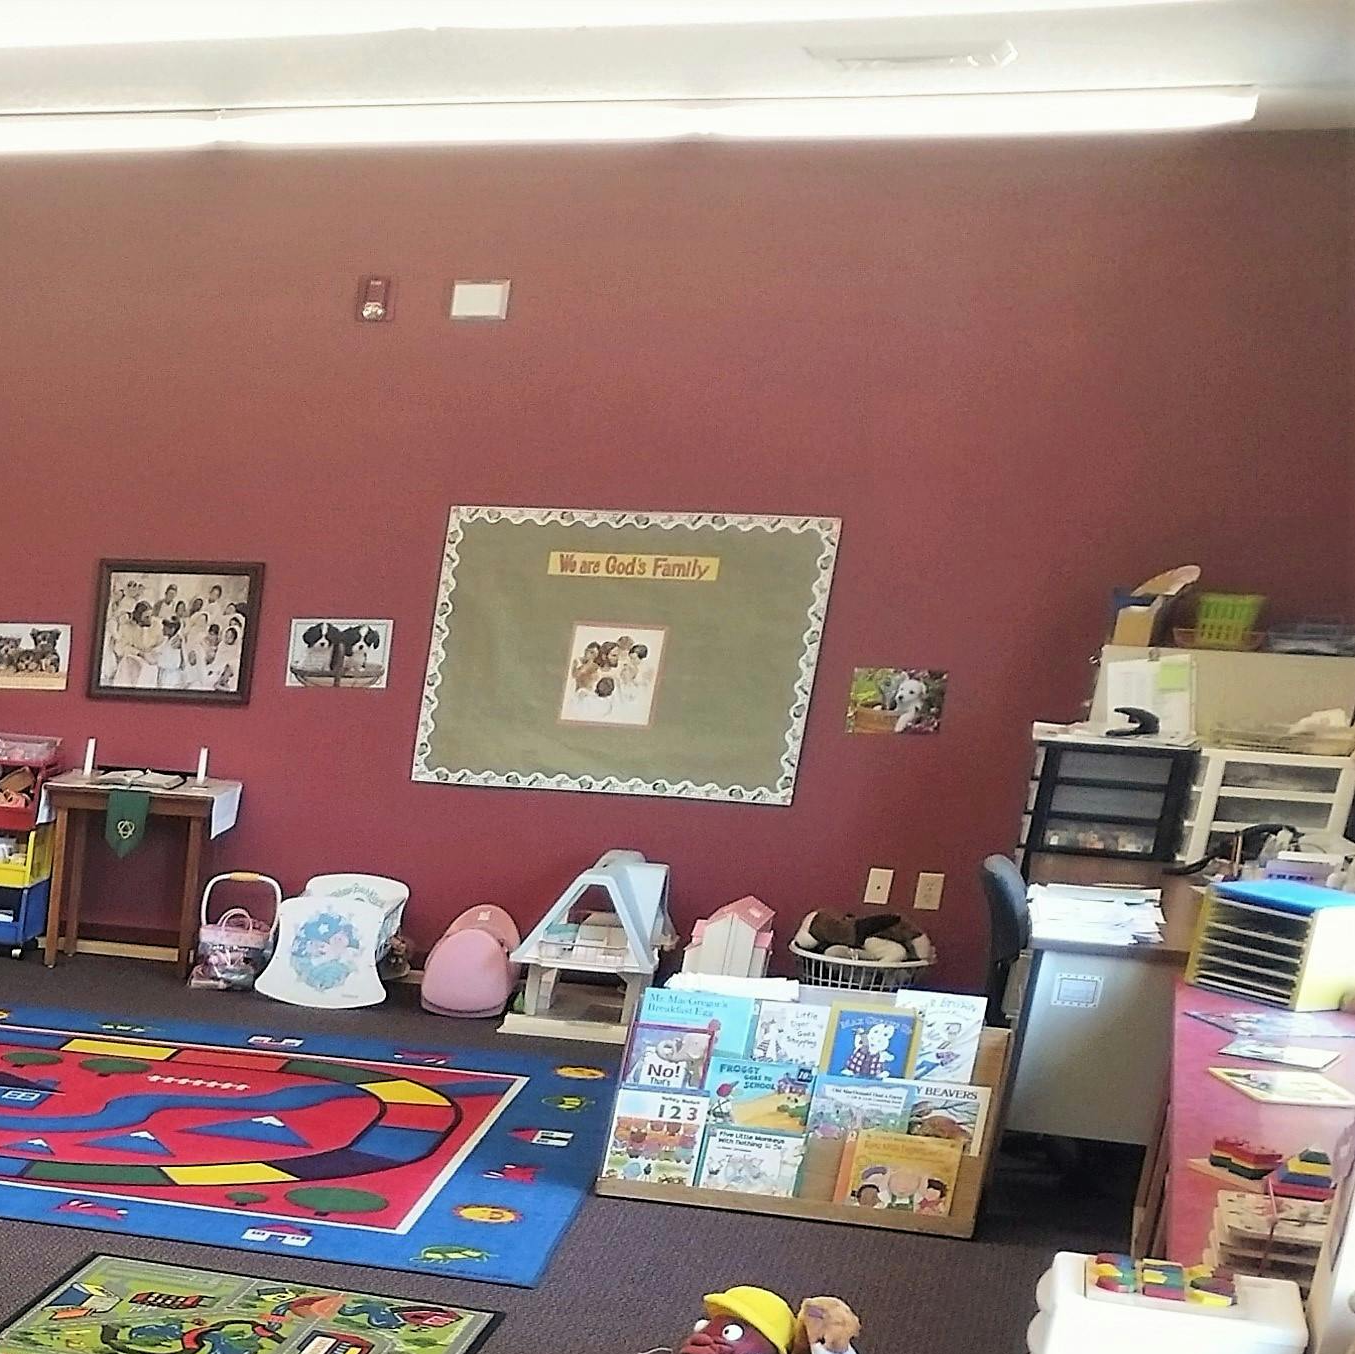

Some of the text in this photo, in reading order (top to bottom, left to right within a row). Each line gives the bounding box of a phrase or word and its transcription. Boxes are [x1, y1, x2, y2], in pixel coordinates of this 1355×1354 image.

[559, 553, 710, 580] We are God's Family
[647, 1063, 681, 1078] No!
[719, 1063, 761, 1074] FROGGY
[743, 1081, 776, 1090] SCHOOL
[925, 1087, 979, 1101] BEAVERS
[658, 1104, 698, 1121] 1 2 3
[735, 1132, 754, 1140] Little
[755, 1135, 785, 1144] Monkeys
